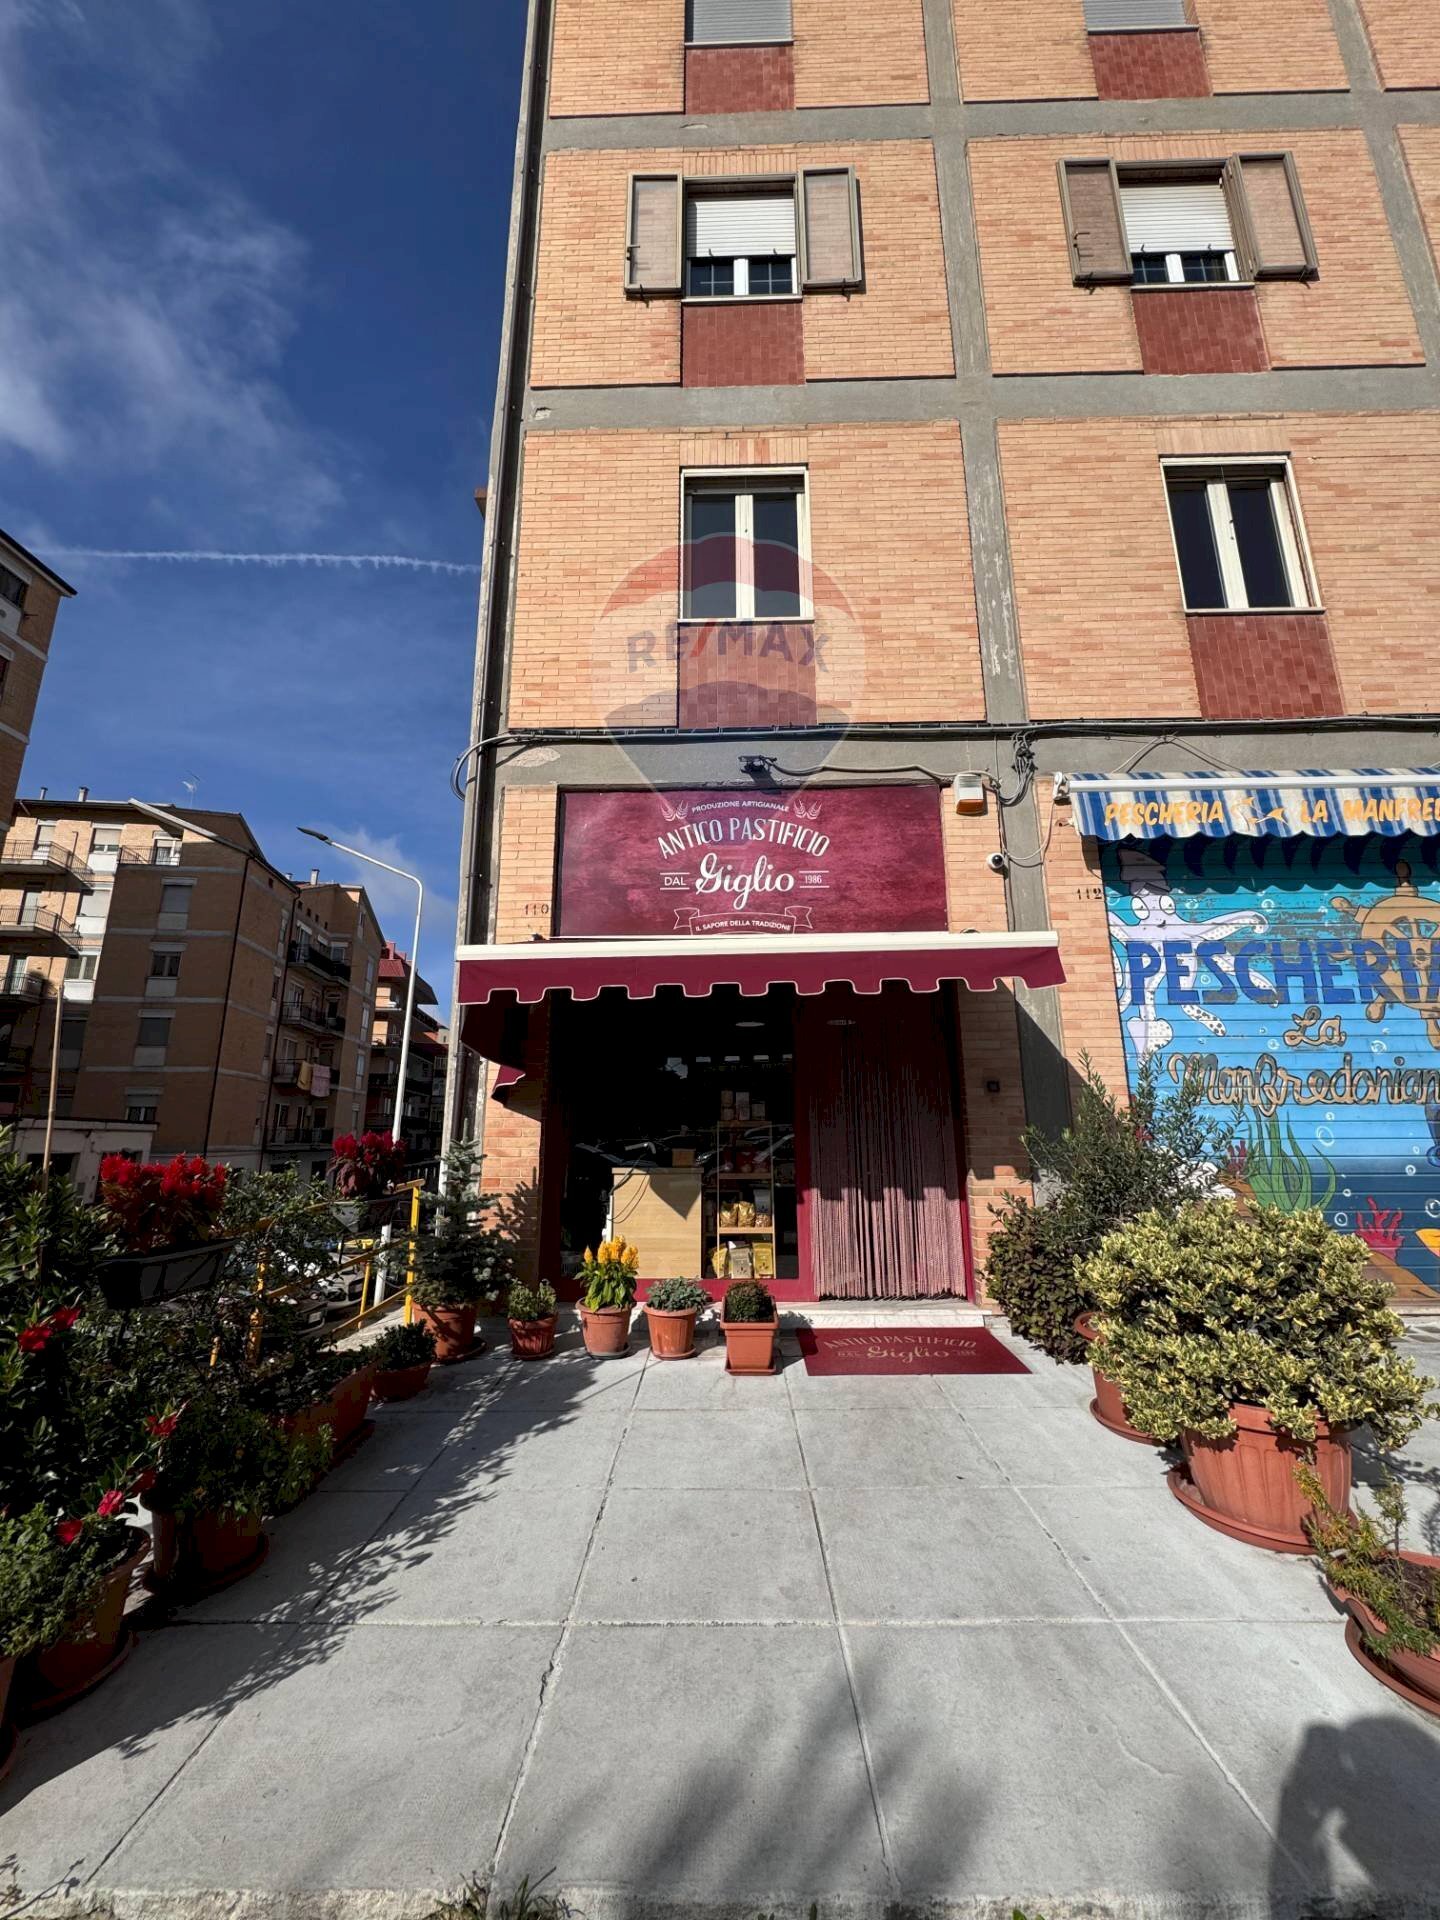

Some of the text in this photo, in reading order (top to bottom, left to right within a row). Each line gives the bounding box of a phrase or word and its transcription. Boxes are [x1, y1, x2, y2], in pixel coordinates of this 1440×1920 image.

[691, 800, 789, 814] PRODUZIONE ARTIGIANALE
[1104, 800, 1225, 826] PESCHERIA
[1300, 799, 1328, 823] LA
[657, 817, 831, 860] ANTICO PASTIFICIO
[664, 852, 822, 910] DAL Giglio 1986
[1077, 888, 1103, 900] 112
[525, 903, 549, 916] 110
[702, 920, 729, 931] SAPORE
[729, 919, 750, 927] DELLA
[752, 919, 791, 931] TRADIZIONE
[1283, 1005, 1347, 1047] La
[824, 1335, 978, 1350] ANTICO PASTIFICIO
[866, 1345, 951, 1364] Giglio
